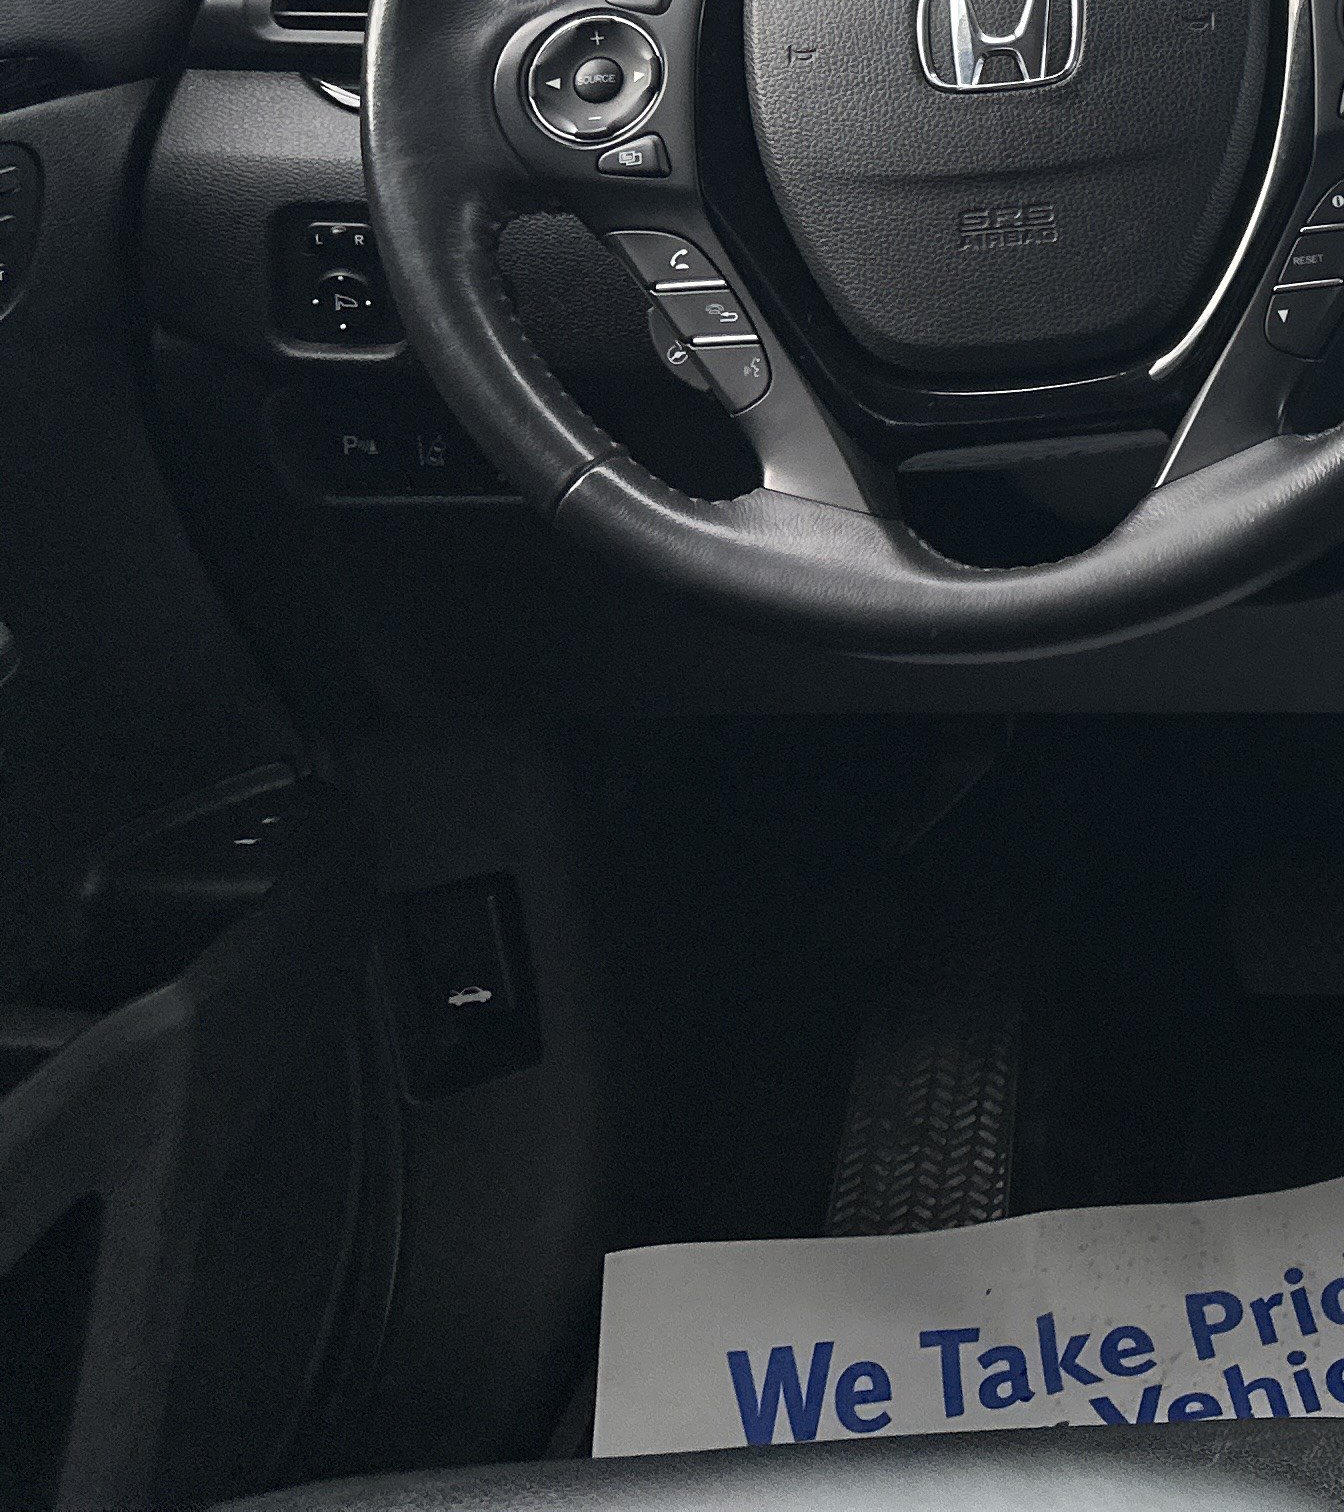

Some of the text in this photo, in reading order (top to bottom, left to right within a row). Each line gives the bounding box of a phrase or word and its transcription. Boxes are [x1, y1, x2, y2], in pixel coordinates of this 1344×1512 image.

[576, 74, 617, 86] SOURCE
[961, 205, 1056, 230] SRS
[314, 234, 324, 246] L
[354, 234, 365, 246] R
[1292, 253, 1324, 266] RESET
[727, 1339, 892, 1446] We
[919, 1312, 1156, 1418] Take
